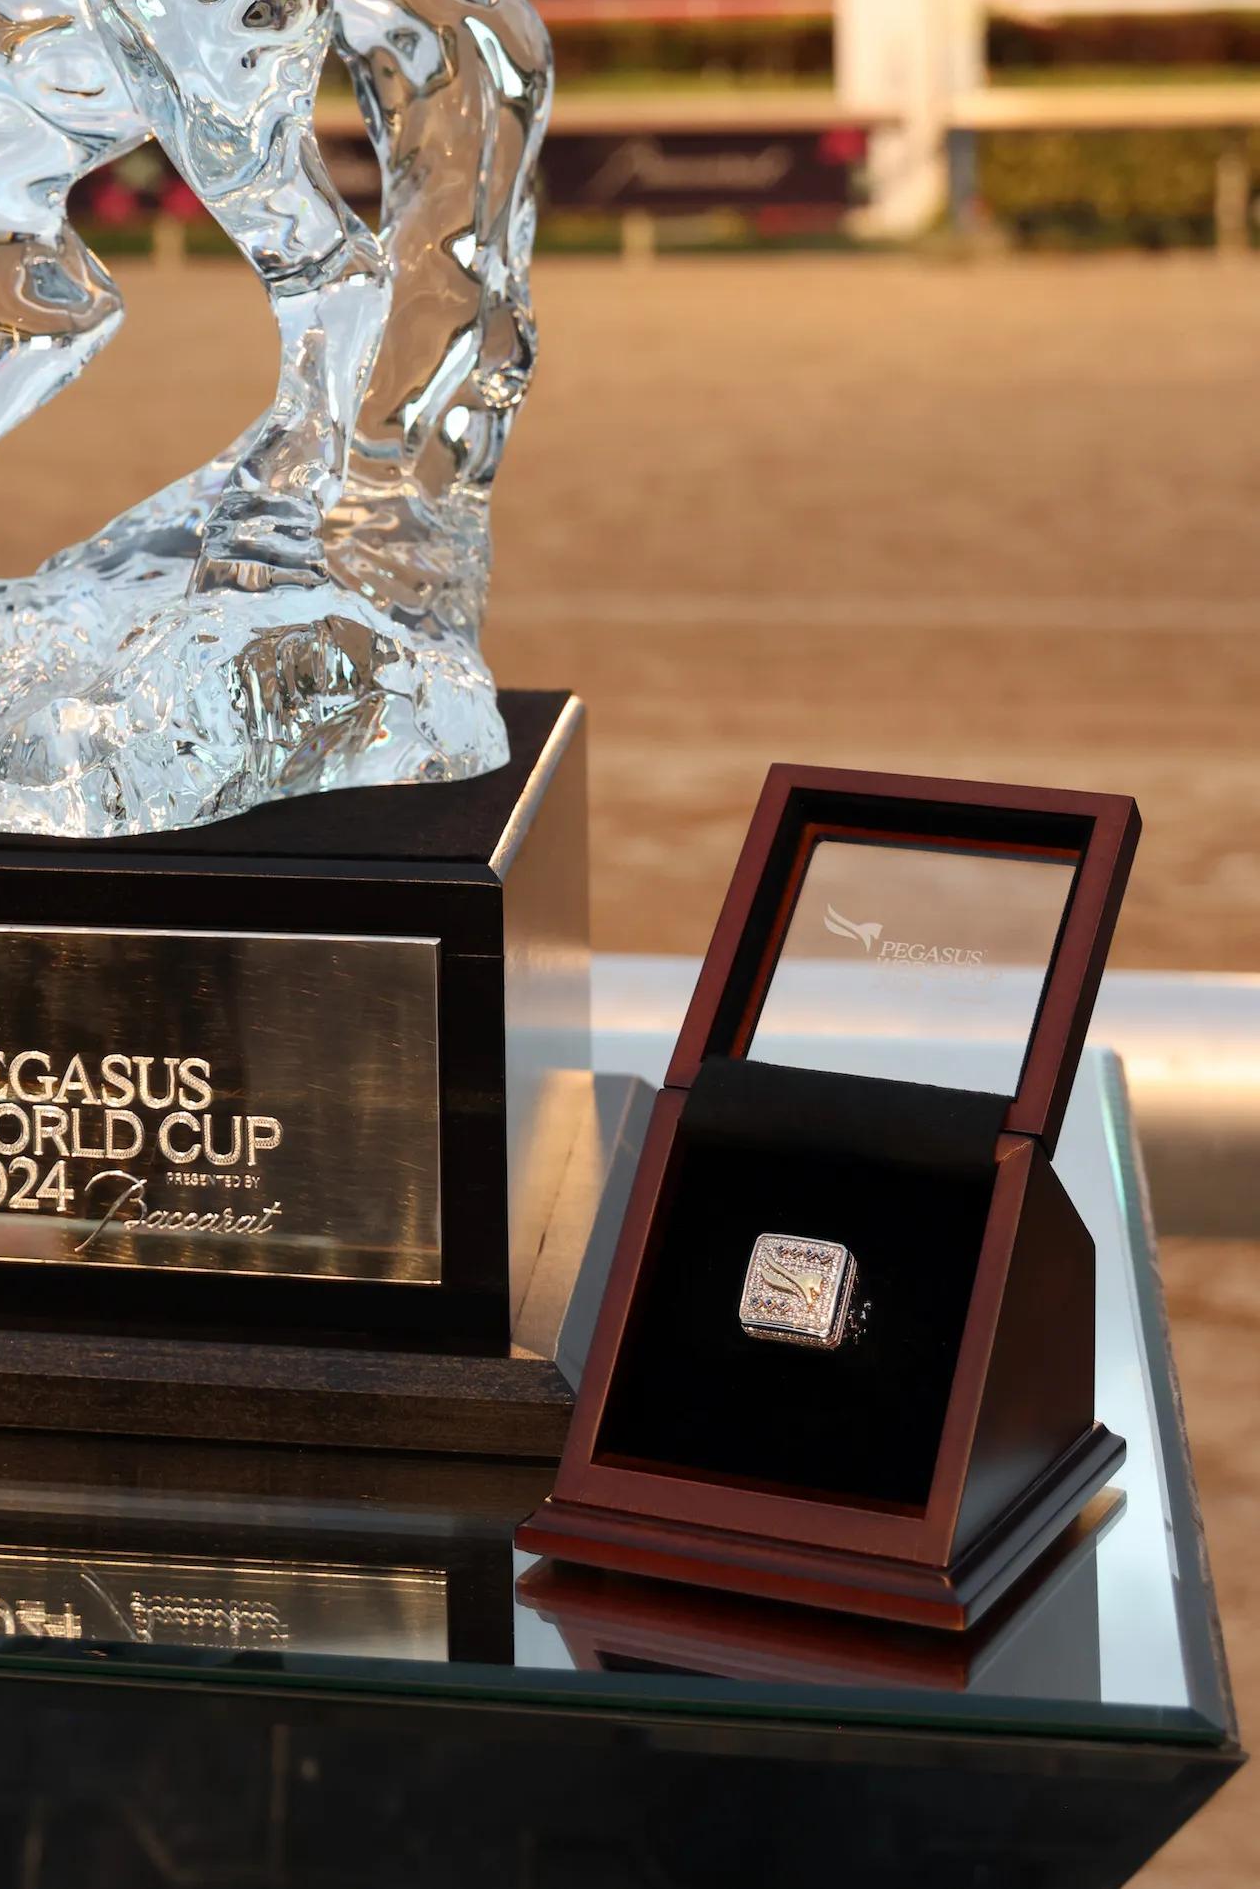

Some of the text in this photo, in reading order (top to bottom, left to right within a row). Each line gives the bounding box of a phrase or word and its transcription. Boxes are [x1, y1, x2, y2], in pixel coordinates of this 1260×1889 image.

[880, 941, 984, 967] PEGASUS
[158, 1111, 283, 1166] CUP
[166, 1171, 261, 1189] PRESENTED BY
[74, 1169, 282, 1252] Baccarat
